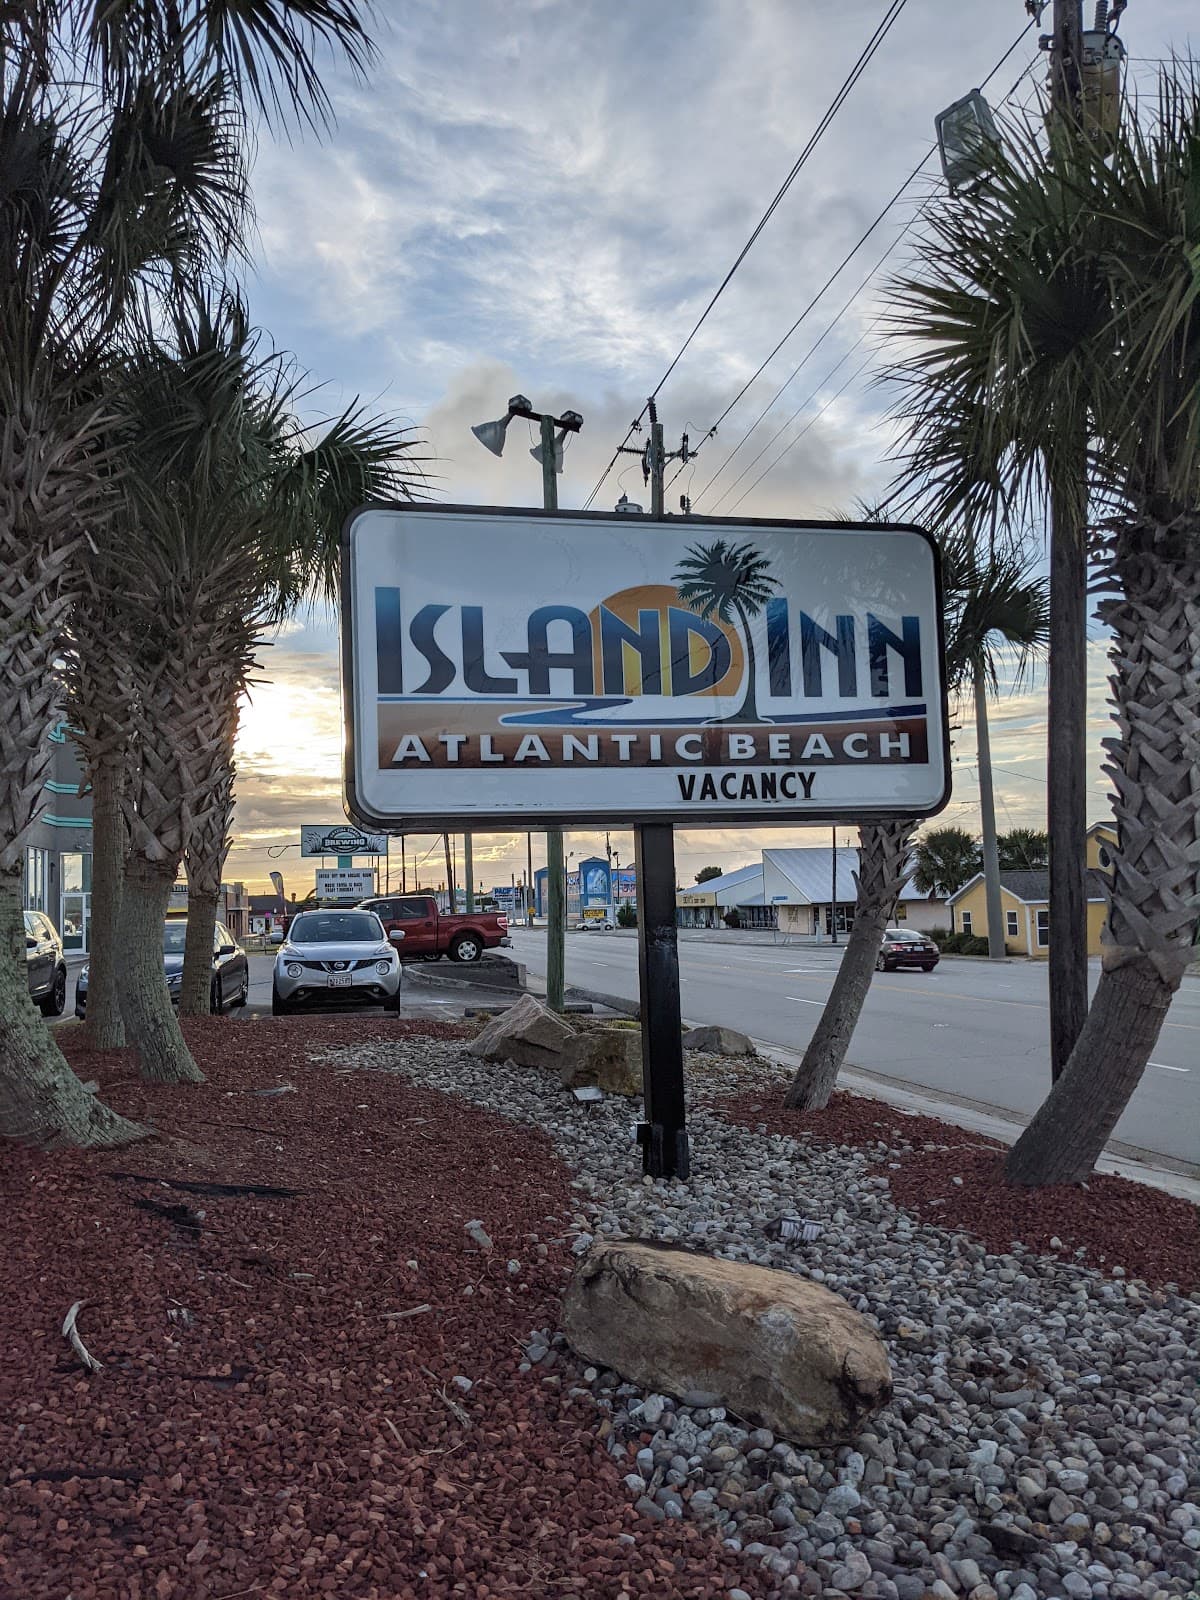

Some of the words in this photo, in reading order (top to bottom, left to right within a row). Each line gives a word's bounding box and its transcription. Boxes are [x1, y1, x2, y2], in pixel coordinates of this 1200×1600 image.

[375, 586, 732, 697] ISLAND
[766, 597, 923, 698] INN
[391, 734, 703, 762] ATLANTIC
[728, 732, 912, 760] BEACH
[677, 771, 817, 801] VACANCY
